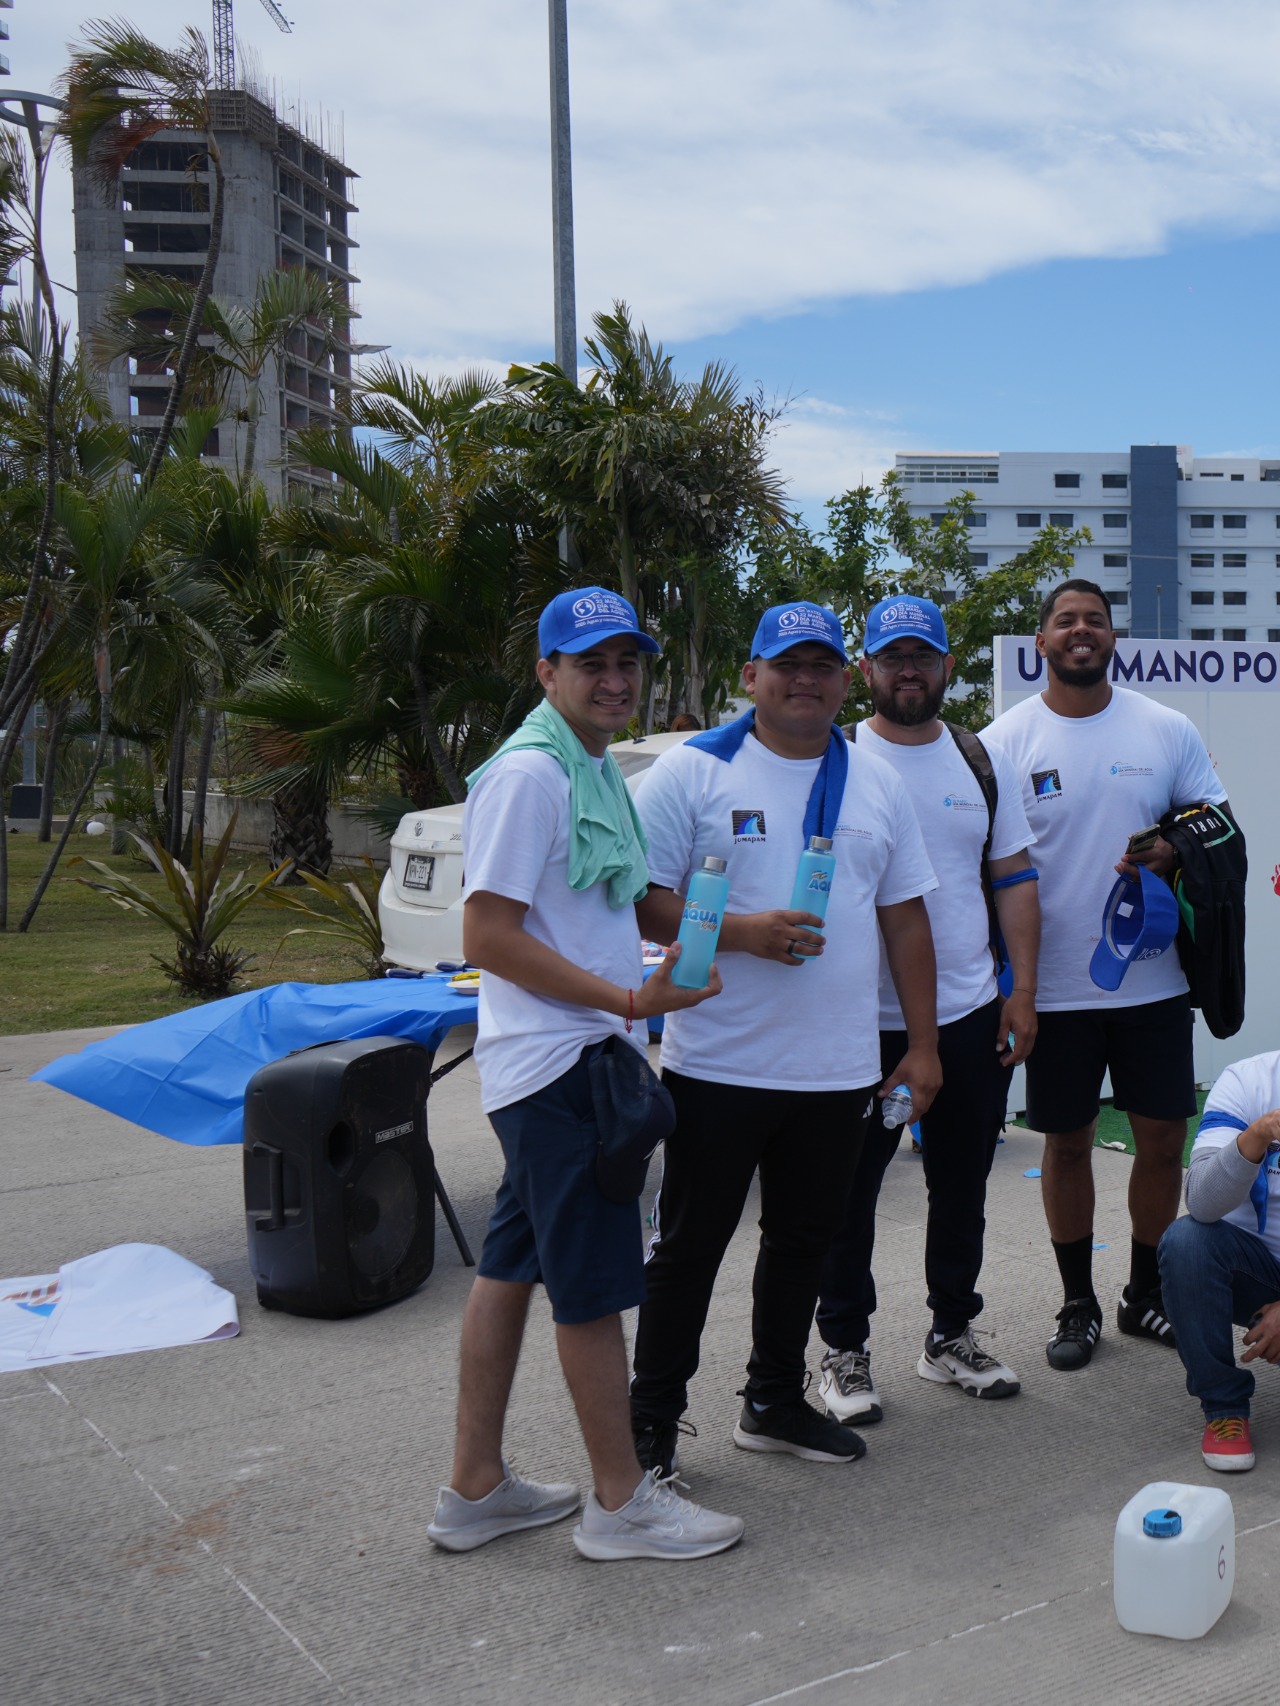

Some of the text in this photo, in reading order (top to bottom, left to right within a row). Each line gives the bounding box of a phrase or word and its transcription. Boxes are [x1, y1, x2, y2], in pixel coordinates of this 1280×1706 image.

[812, 622, 826, 630] AGUA
[1112, 650, 1224, 683] MANO
[1217, 1544, 1226, 1580] 6
